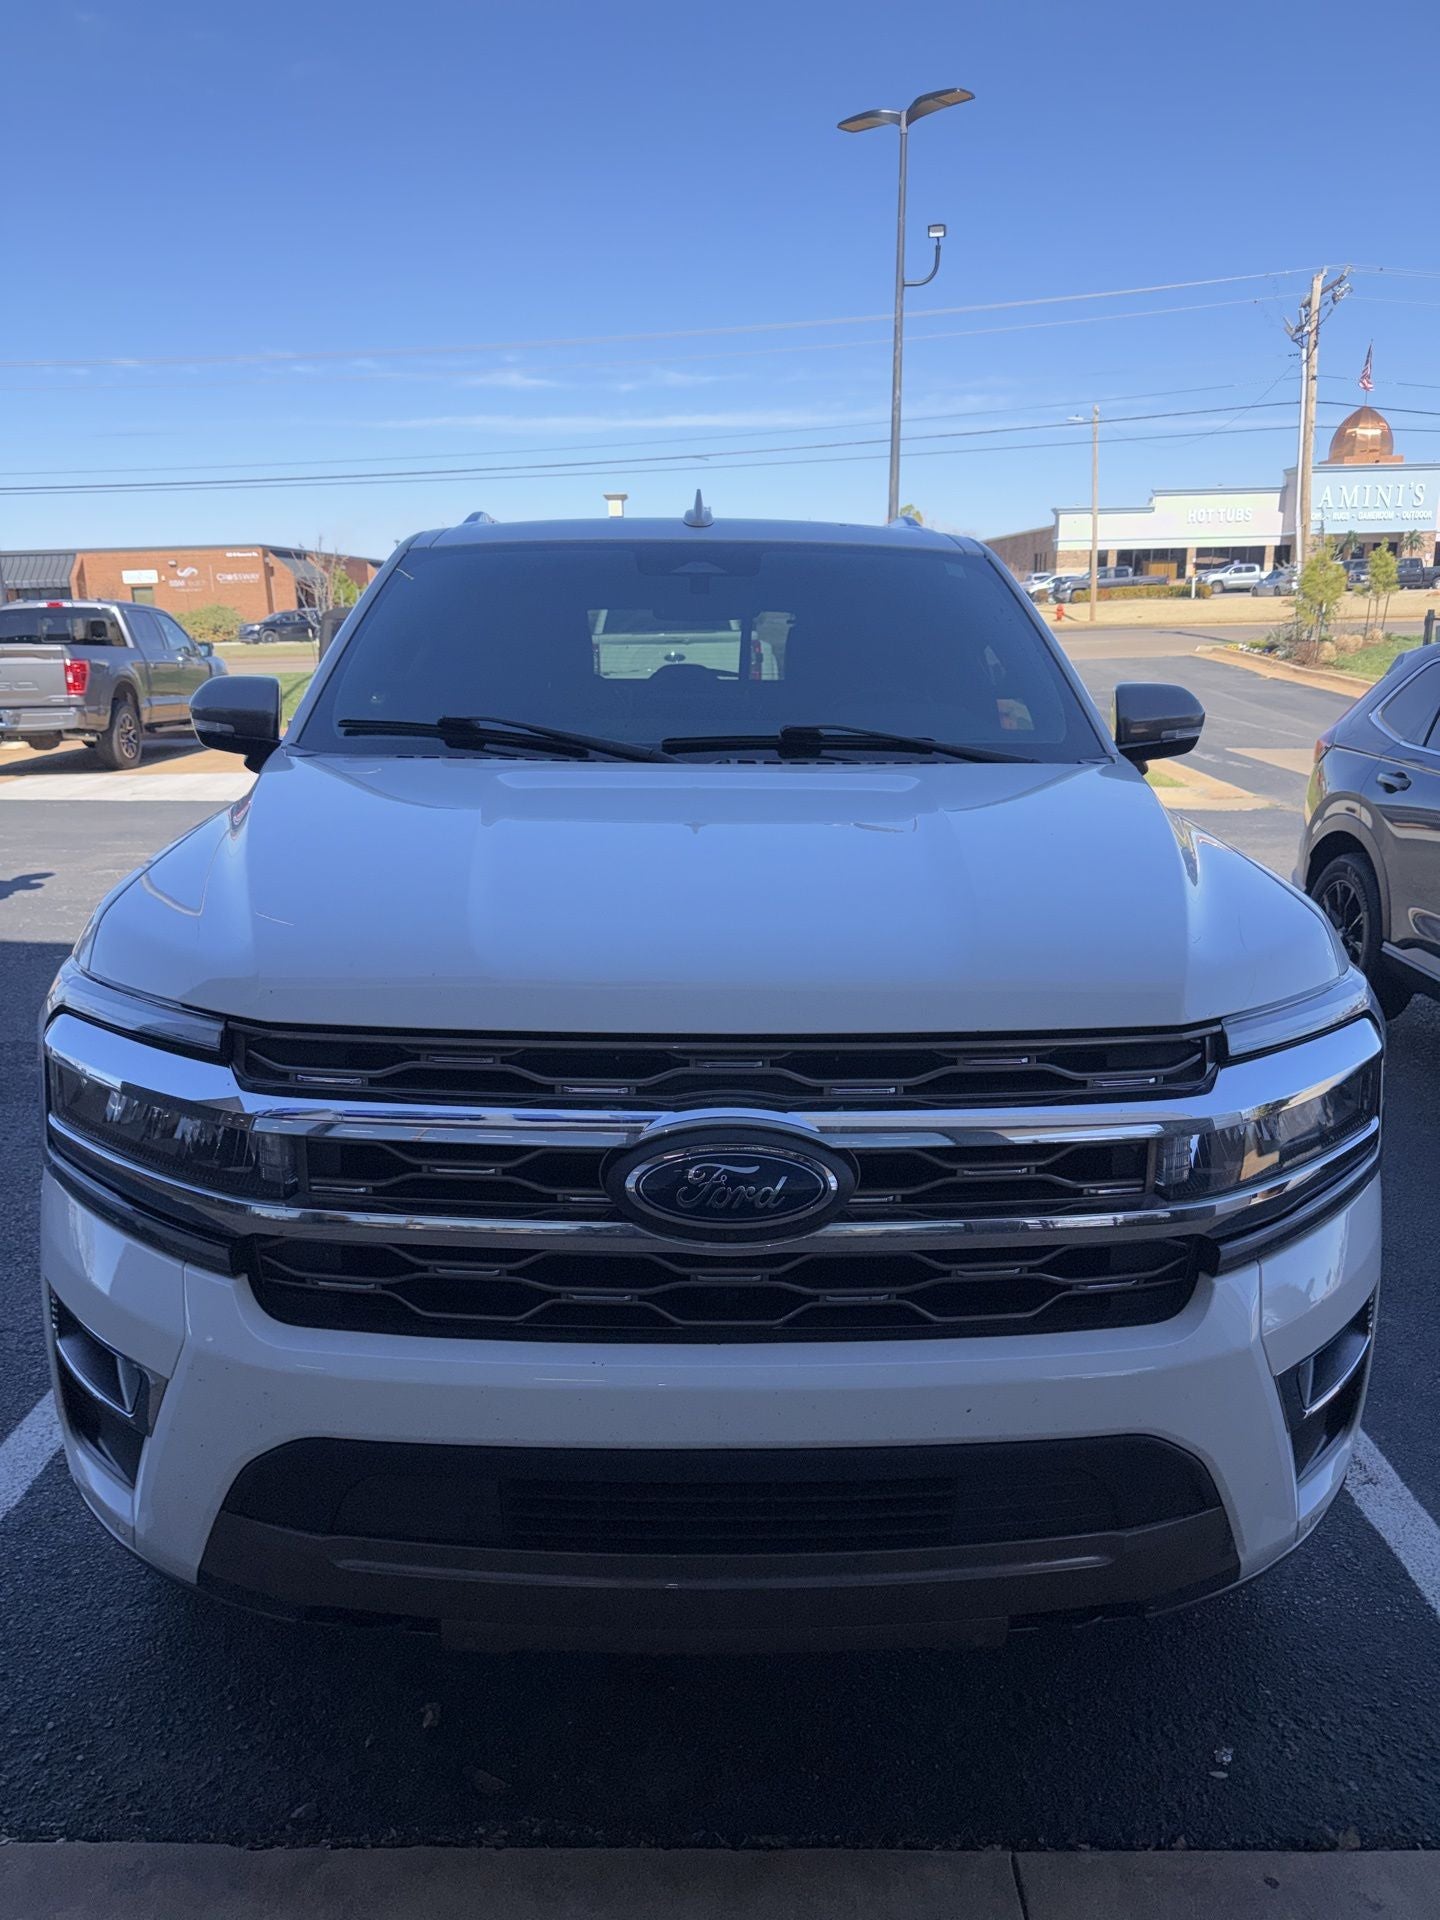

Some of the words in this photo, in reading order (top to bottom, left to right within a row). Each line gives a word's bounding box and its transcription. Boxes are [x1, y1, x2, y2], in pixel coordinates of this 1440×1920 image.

[1317, 482, 1427, 509] AMINI'S
[1187, 508, 1214, 523] HOT
[1217, 506, 1253, 522] TUBS
[1401, 509, 1433, 520] OUTDOOR
[676, 1162, 788, 1209] Ford
